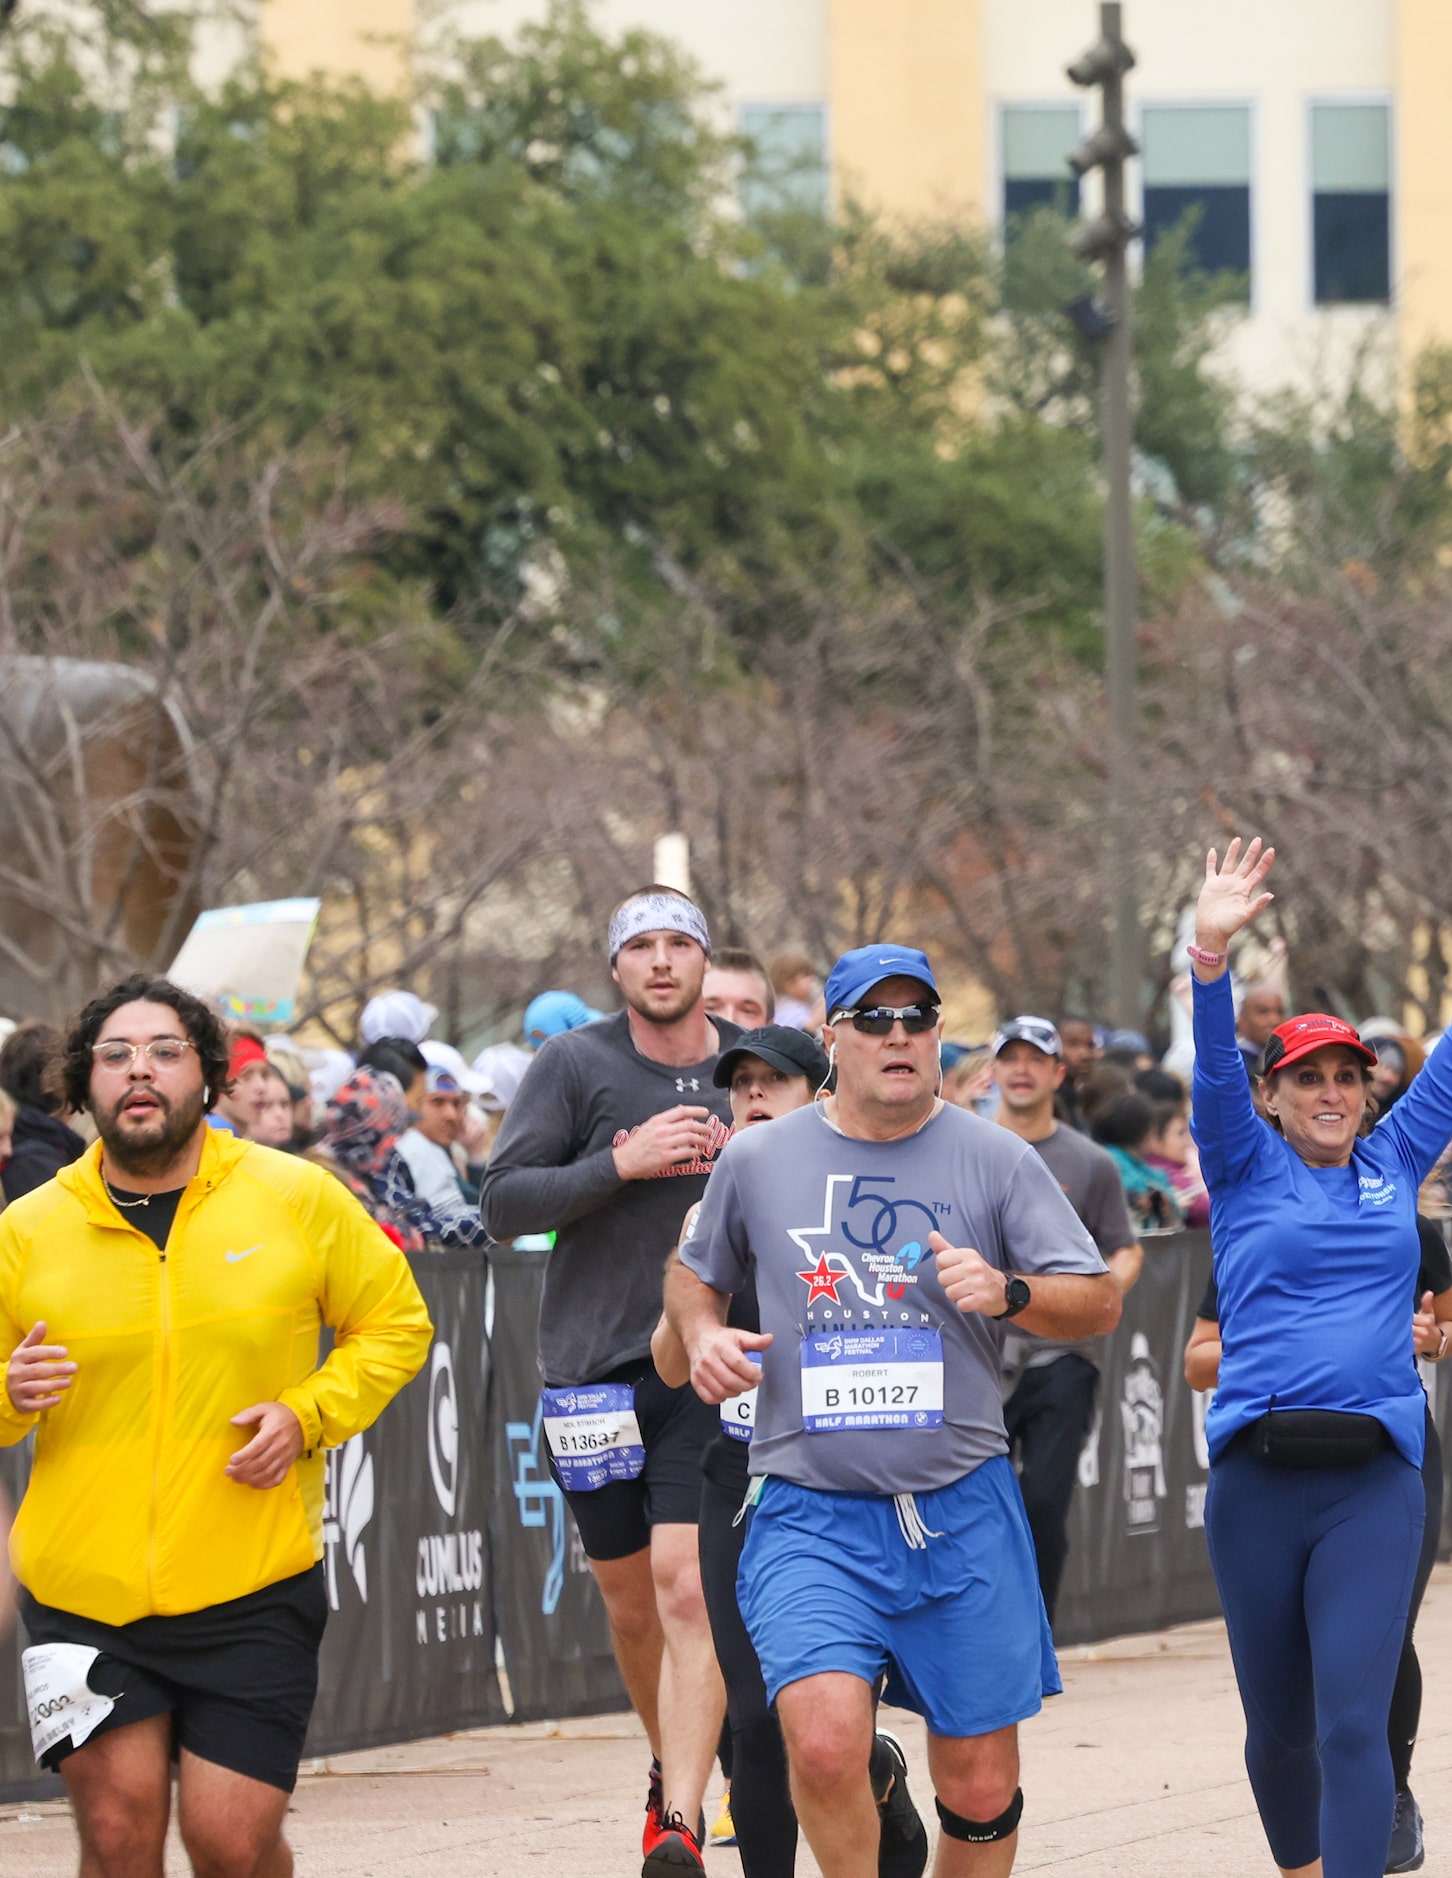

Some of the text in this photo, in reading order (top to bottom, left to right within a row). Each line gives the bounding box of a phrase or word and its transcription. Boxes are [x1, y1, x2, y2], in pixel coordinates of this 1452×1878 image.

[861, 1252, 895, 1264] Chevron
[868, 1262, 904, 1273] Houston
[813, 1275, 831, 1286] 26.2
[878, 1272, 918, 1284] Marathon
[807, 1309, 930, 1323] HOUSTON
[860, 1336, 885, 1344] DALLAS
[852, 1369, 889, 1378] ROBERT
[826, 1386, 919, 1407] B 10127
[737, 1402, 750, 1419] C
[815, 1414, 909, 1428] HALF MARATHON
[728, 1425, 751, 1438] HALF
[559, 1431, 620, 1451] B 13637
